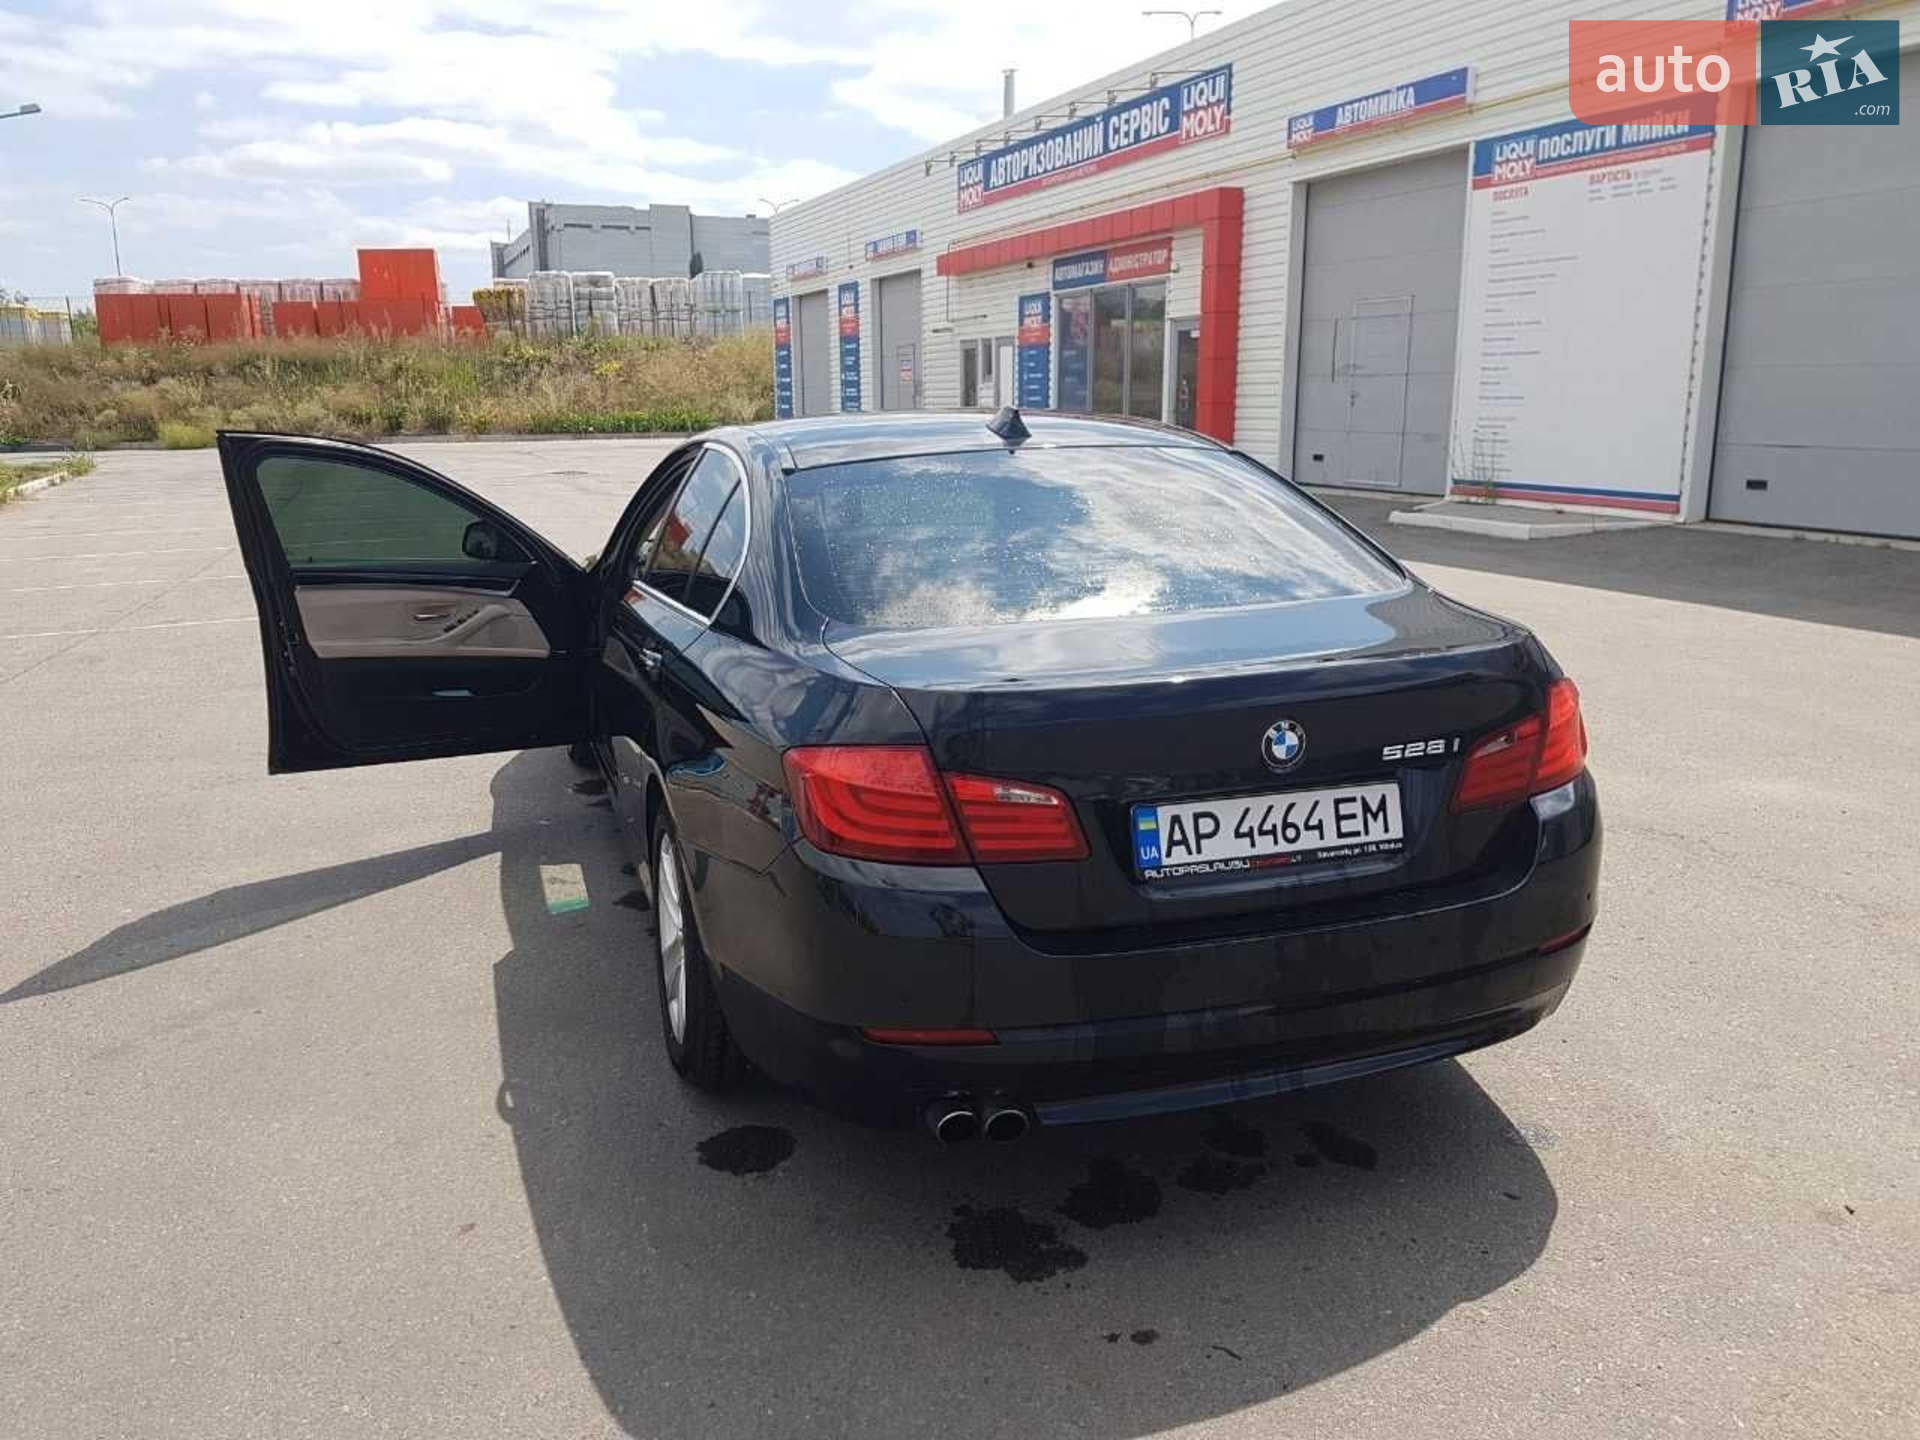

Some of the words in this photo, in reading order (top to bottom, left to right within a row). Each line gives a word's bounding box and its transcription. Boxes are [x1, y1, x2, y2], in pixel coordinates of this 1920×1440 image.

[1183, 75, 1226, 111] LIQUI
[1335, 86, 1416, 127] АВТОМИЙКА
[1182, 104, 1225, 139] MOLY
[1538, 122, 1617, 160] ПОСЛУГИ
[1621, 109, 1691, 145] МИЙКИ
[990, 117, 1105, 188] АВТОРИЗОВАНИЙ
[1108, 97, 1171, 151] СЕРВІС
[1495, 139, 1535, 162] LIQUI
[960, 162, 983, 187] LIQUI
[1494, 157, 1536, 182] MOLY
[960, 183, 984, 208] MOLY
[1165, 811, 1220, 858] AP
[1234, 800, 1325, 848] 4464
[1333, 793, 1390, 839] EM
[1141, 845, 1159, 860] UA
